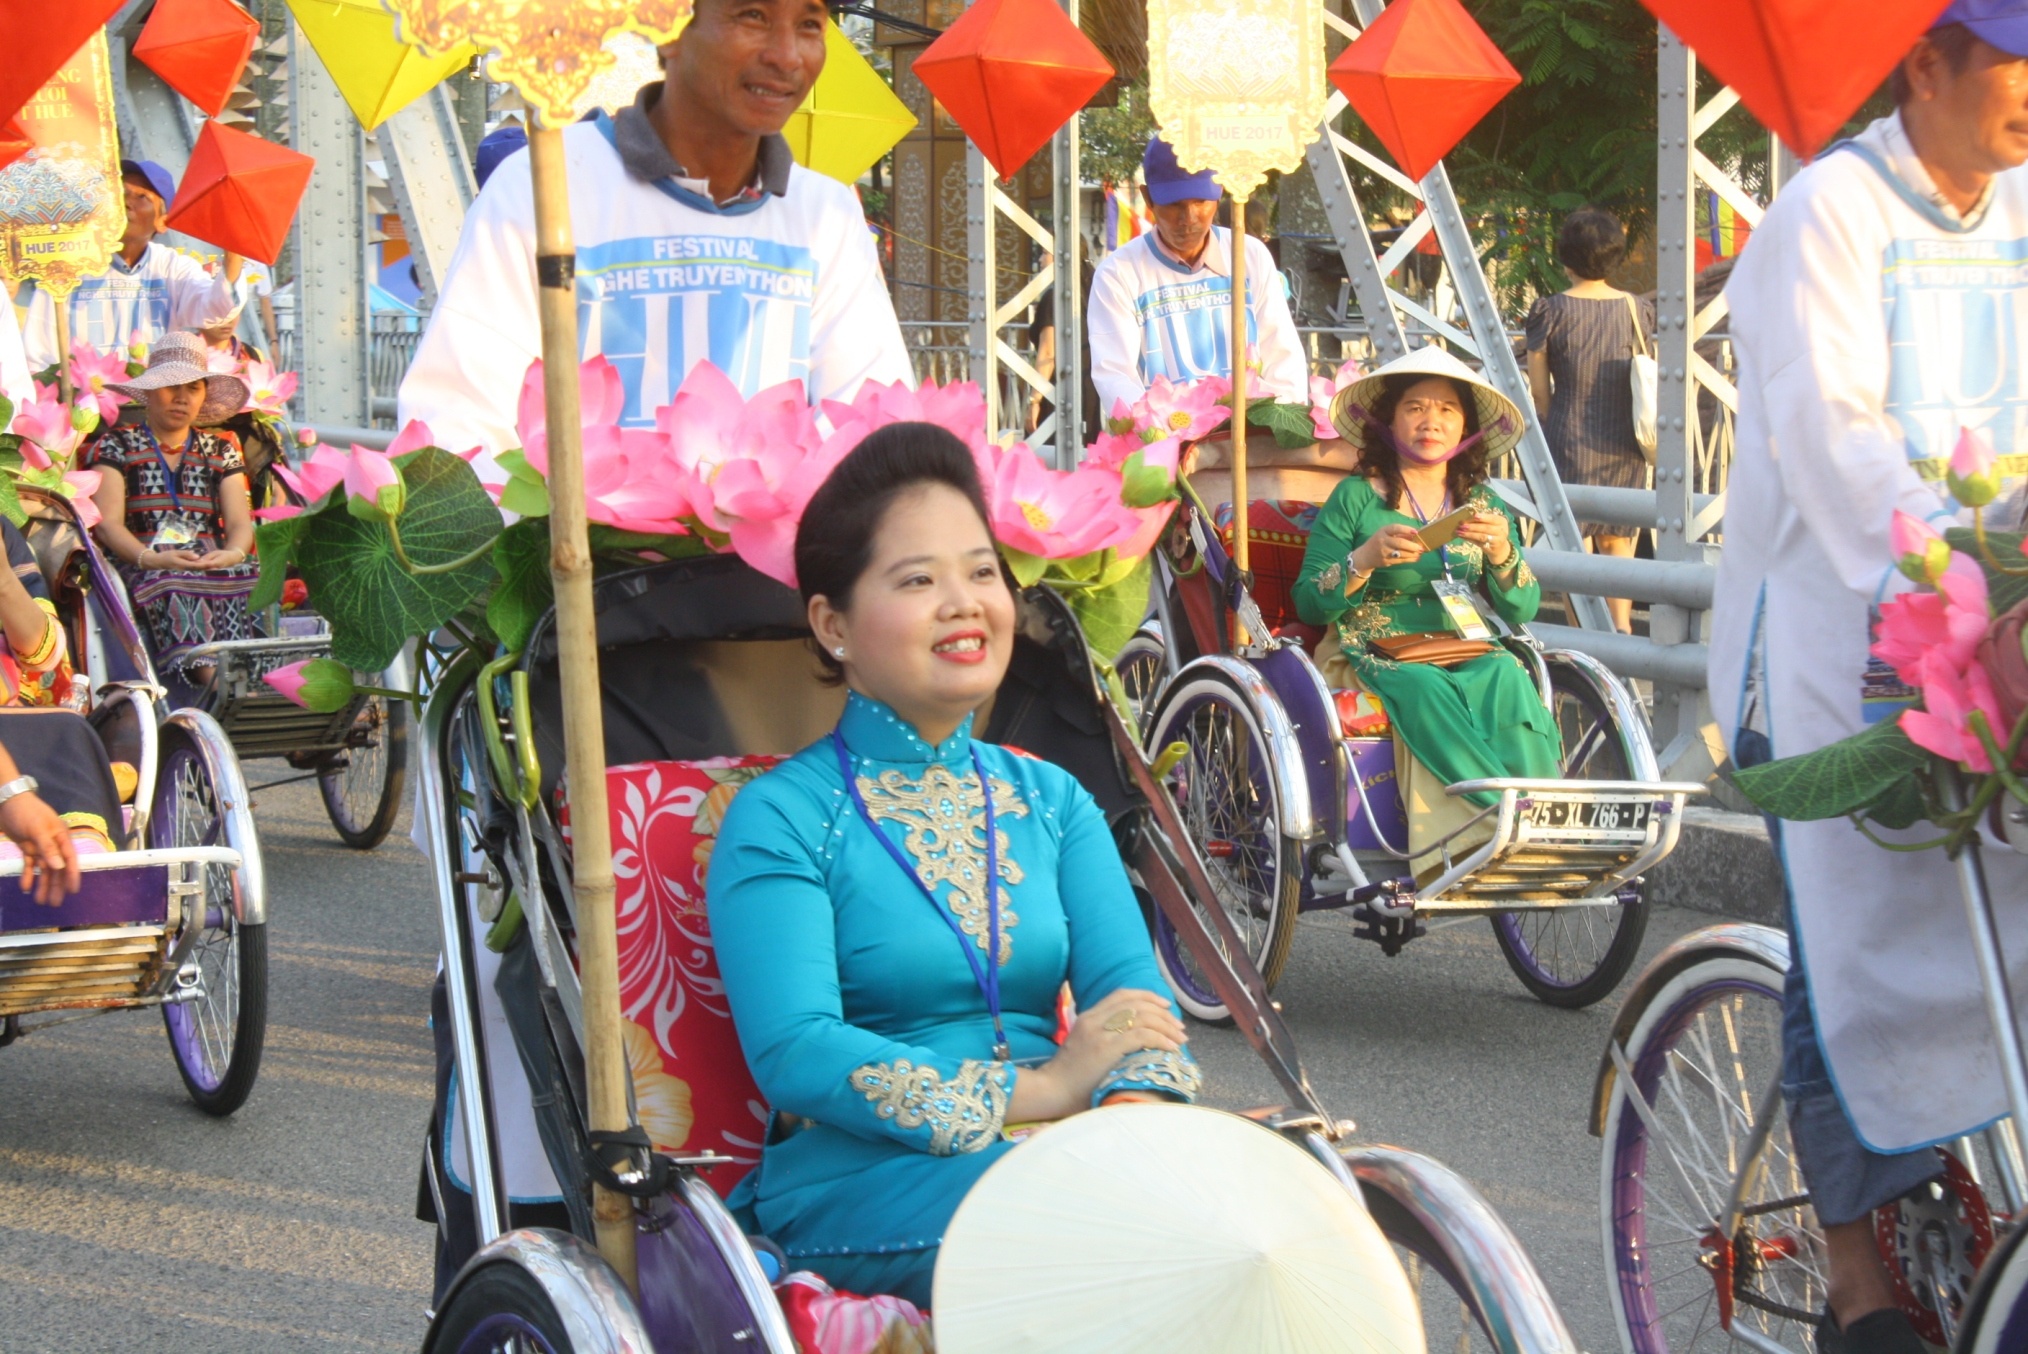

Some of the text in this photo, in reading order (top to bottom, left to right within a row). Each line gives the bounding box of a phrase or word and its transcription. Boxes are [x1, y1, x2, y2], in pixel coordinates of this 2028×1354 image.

[35, 103, 75, 119] HUE
[1206, 126, 1283, 140] HUE 2017
[25, 240, 90, 255] HUE 2017
[653, 237, 759, 260] FESTIVAL
[746, 269, 813, 298] THON
[1154, 281, 1211, 301] FESTIVAL
[1206, 293, 1232, 306] THO
